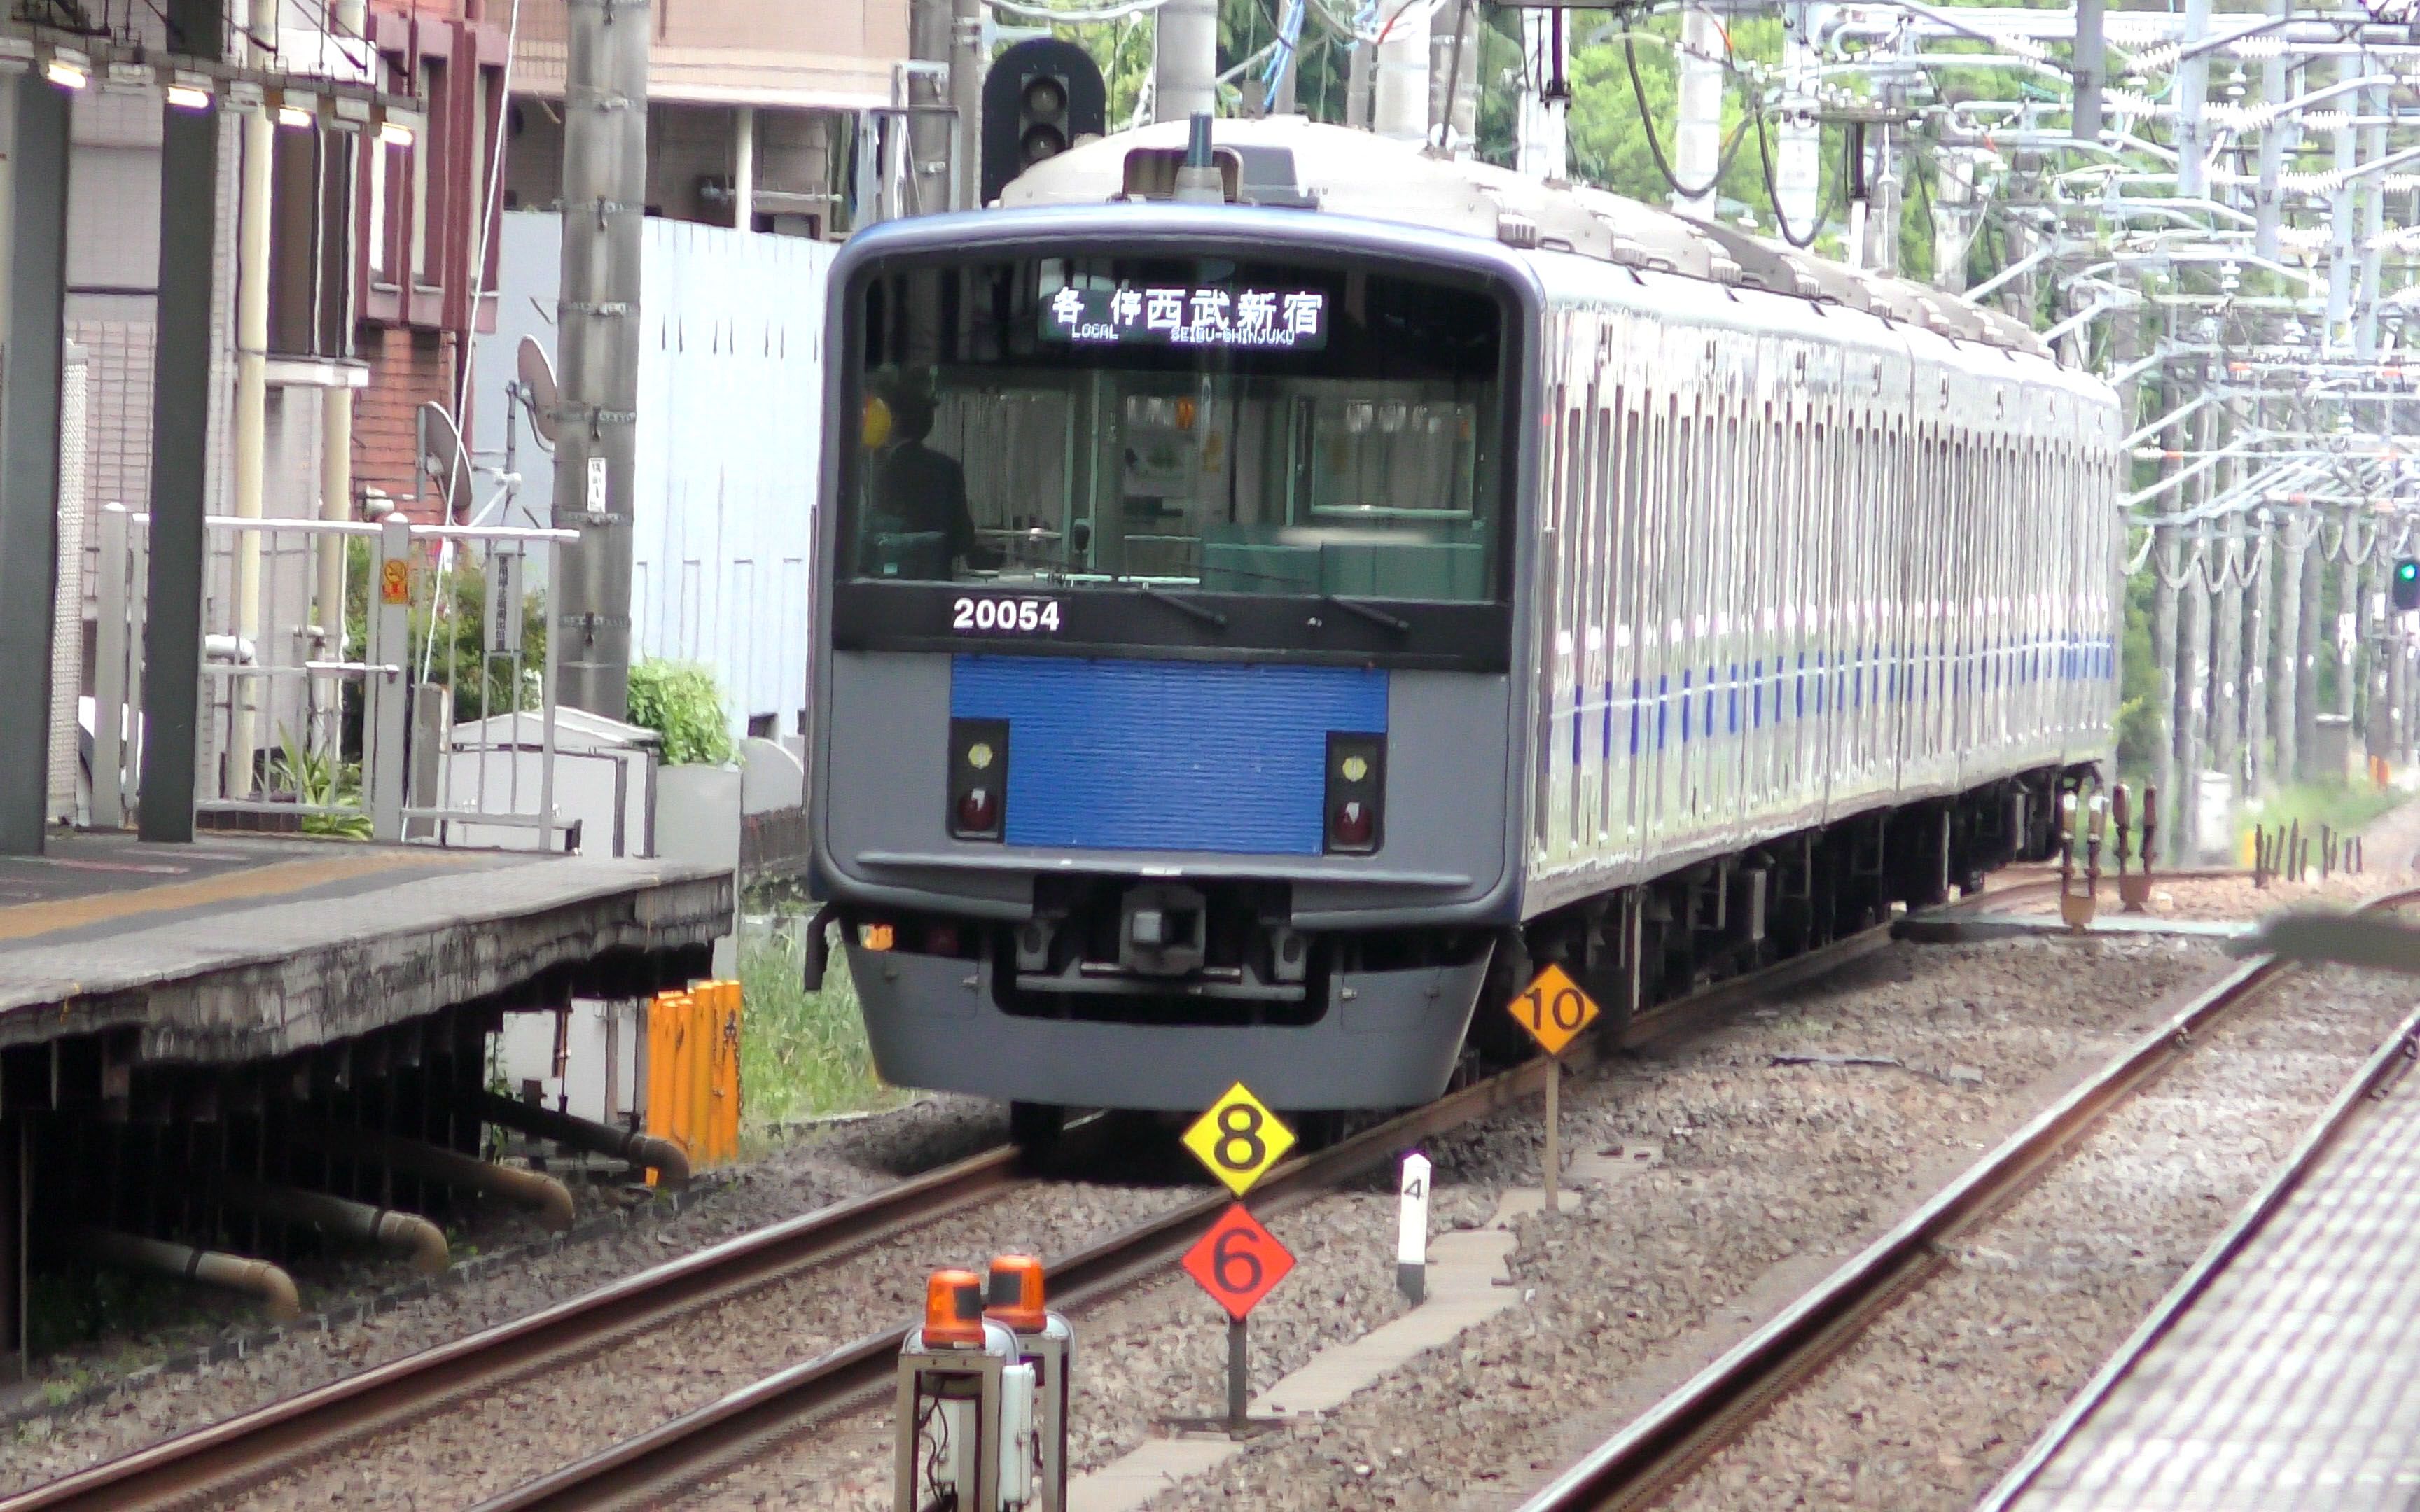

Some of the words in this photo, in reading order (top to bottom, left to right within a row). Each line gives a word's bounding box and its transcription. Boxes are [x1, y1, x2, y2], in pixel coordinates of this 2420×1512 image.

[1146, 288, 1323, 334] 西武新宿
[1071, 323, 1119, 341] LOCAL
[1171, 326, 1295, 346] SEIBU-SHINJUKU
[953, 598, 1060, 631] 20054
[1524, 987, 1585, 1031] 10
[1214, 1103, 1266, 1172] 8
[1404, 1177, 1421, 1200] 4
[1214, 1228, 1263, 1294] 6
